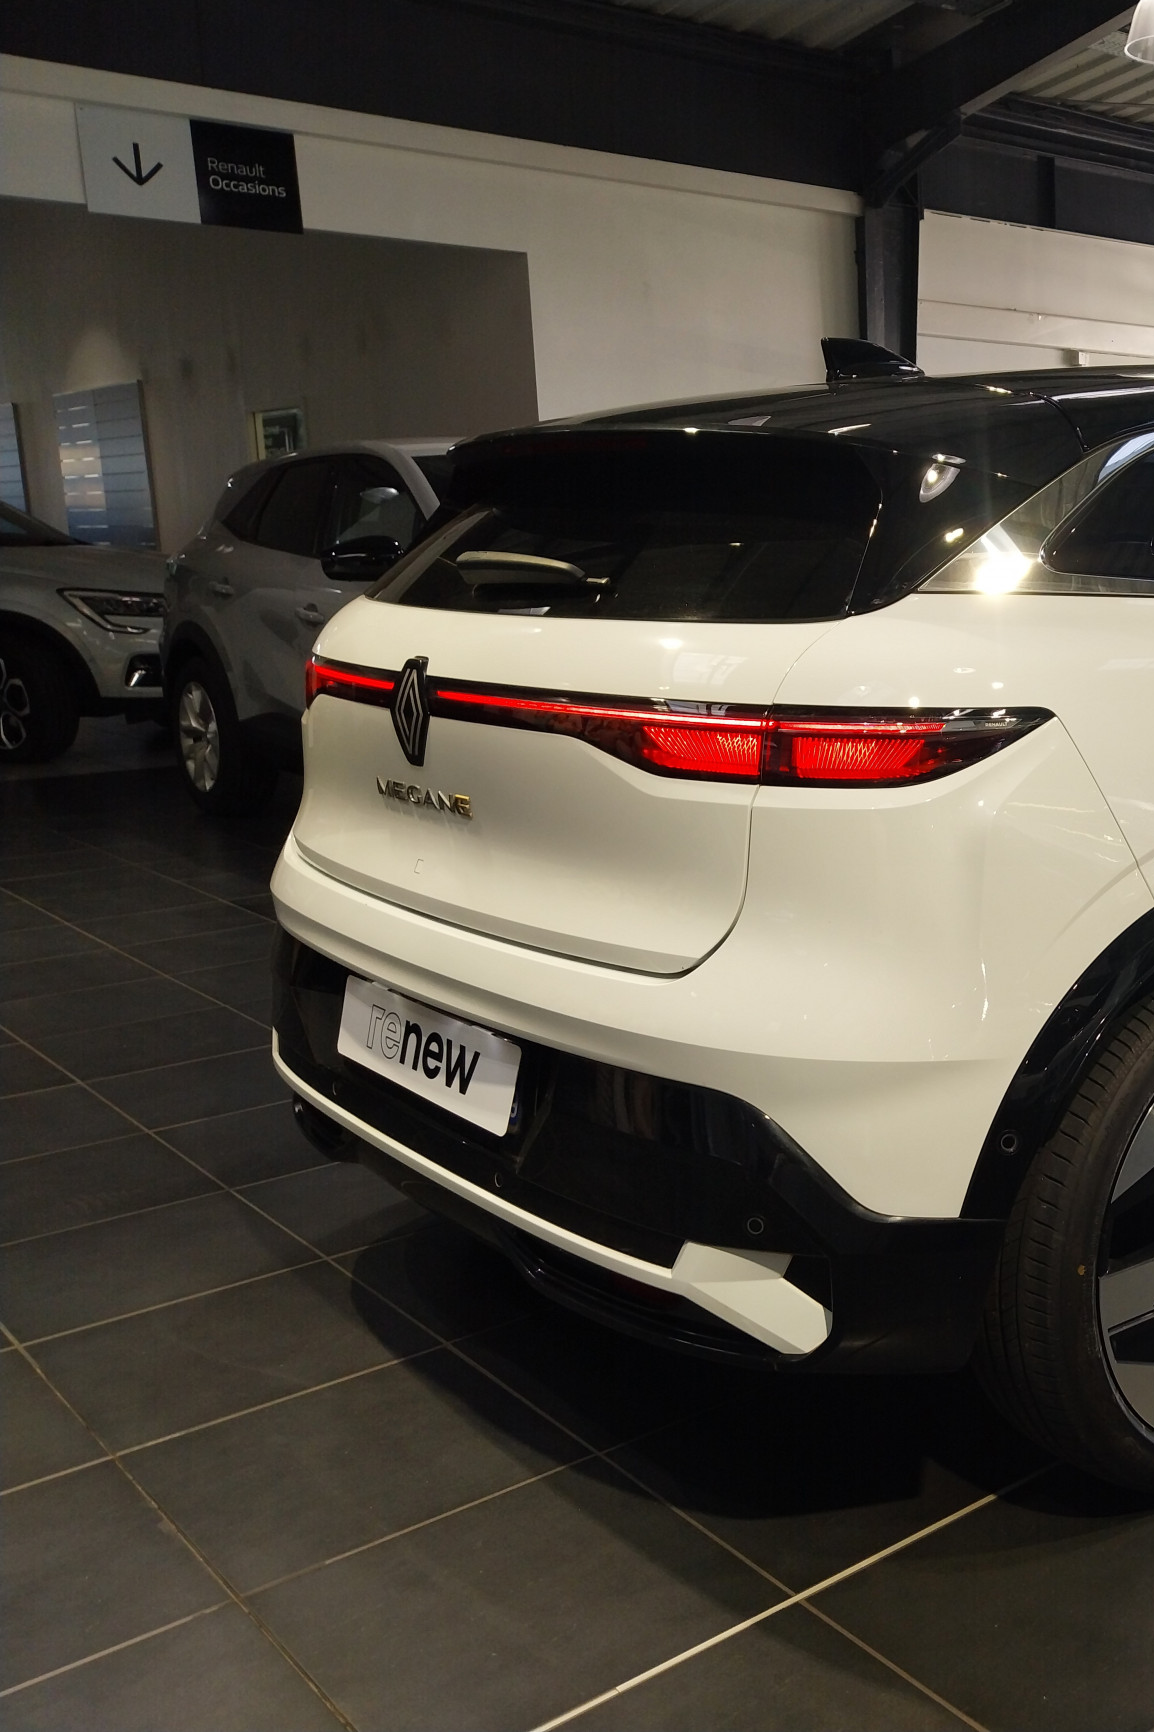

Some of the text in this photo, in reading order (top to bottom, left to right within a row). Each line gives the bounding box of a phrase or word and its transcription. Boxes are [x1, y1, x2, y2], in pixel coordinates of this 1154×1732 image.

[207, 157, 266, 178] Renault
[209, 175, 287, 198] Occasions
[376, 775, 473, 820] MEGANE
[366, 1003, 481, 1096] renew
